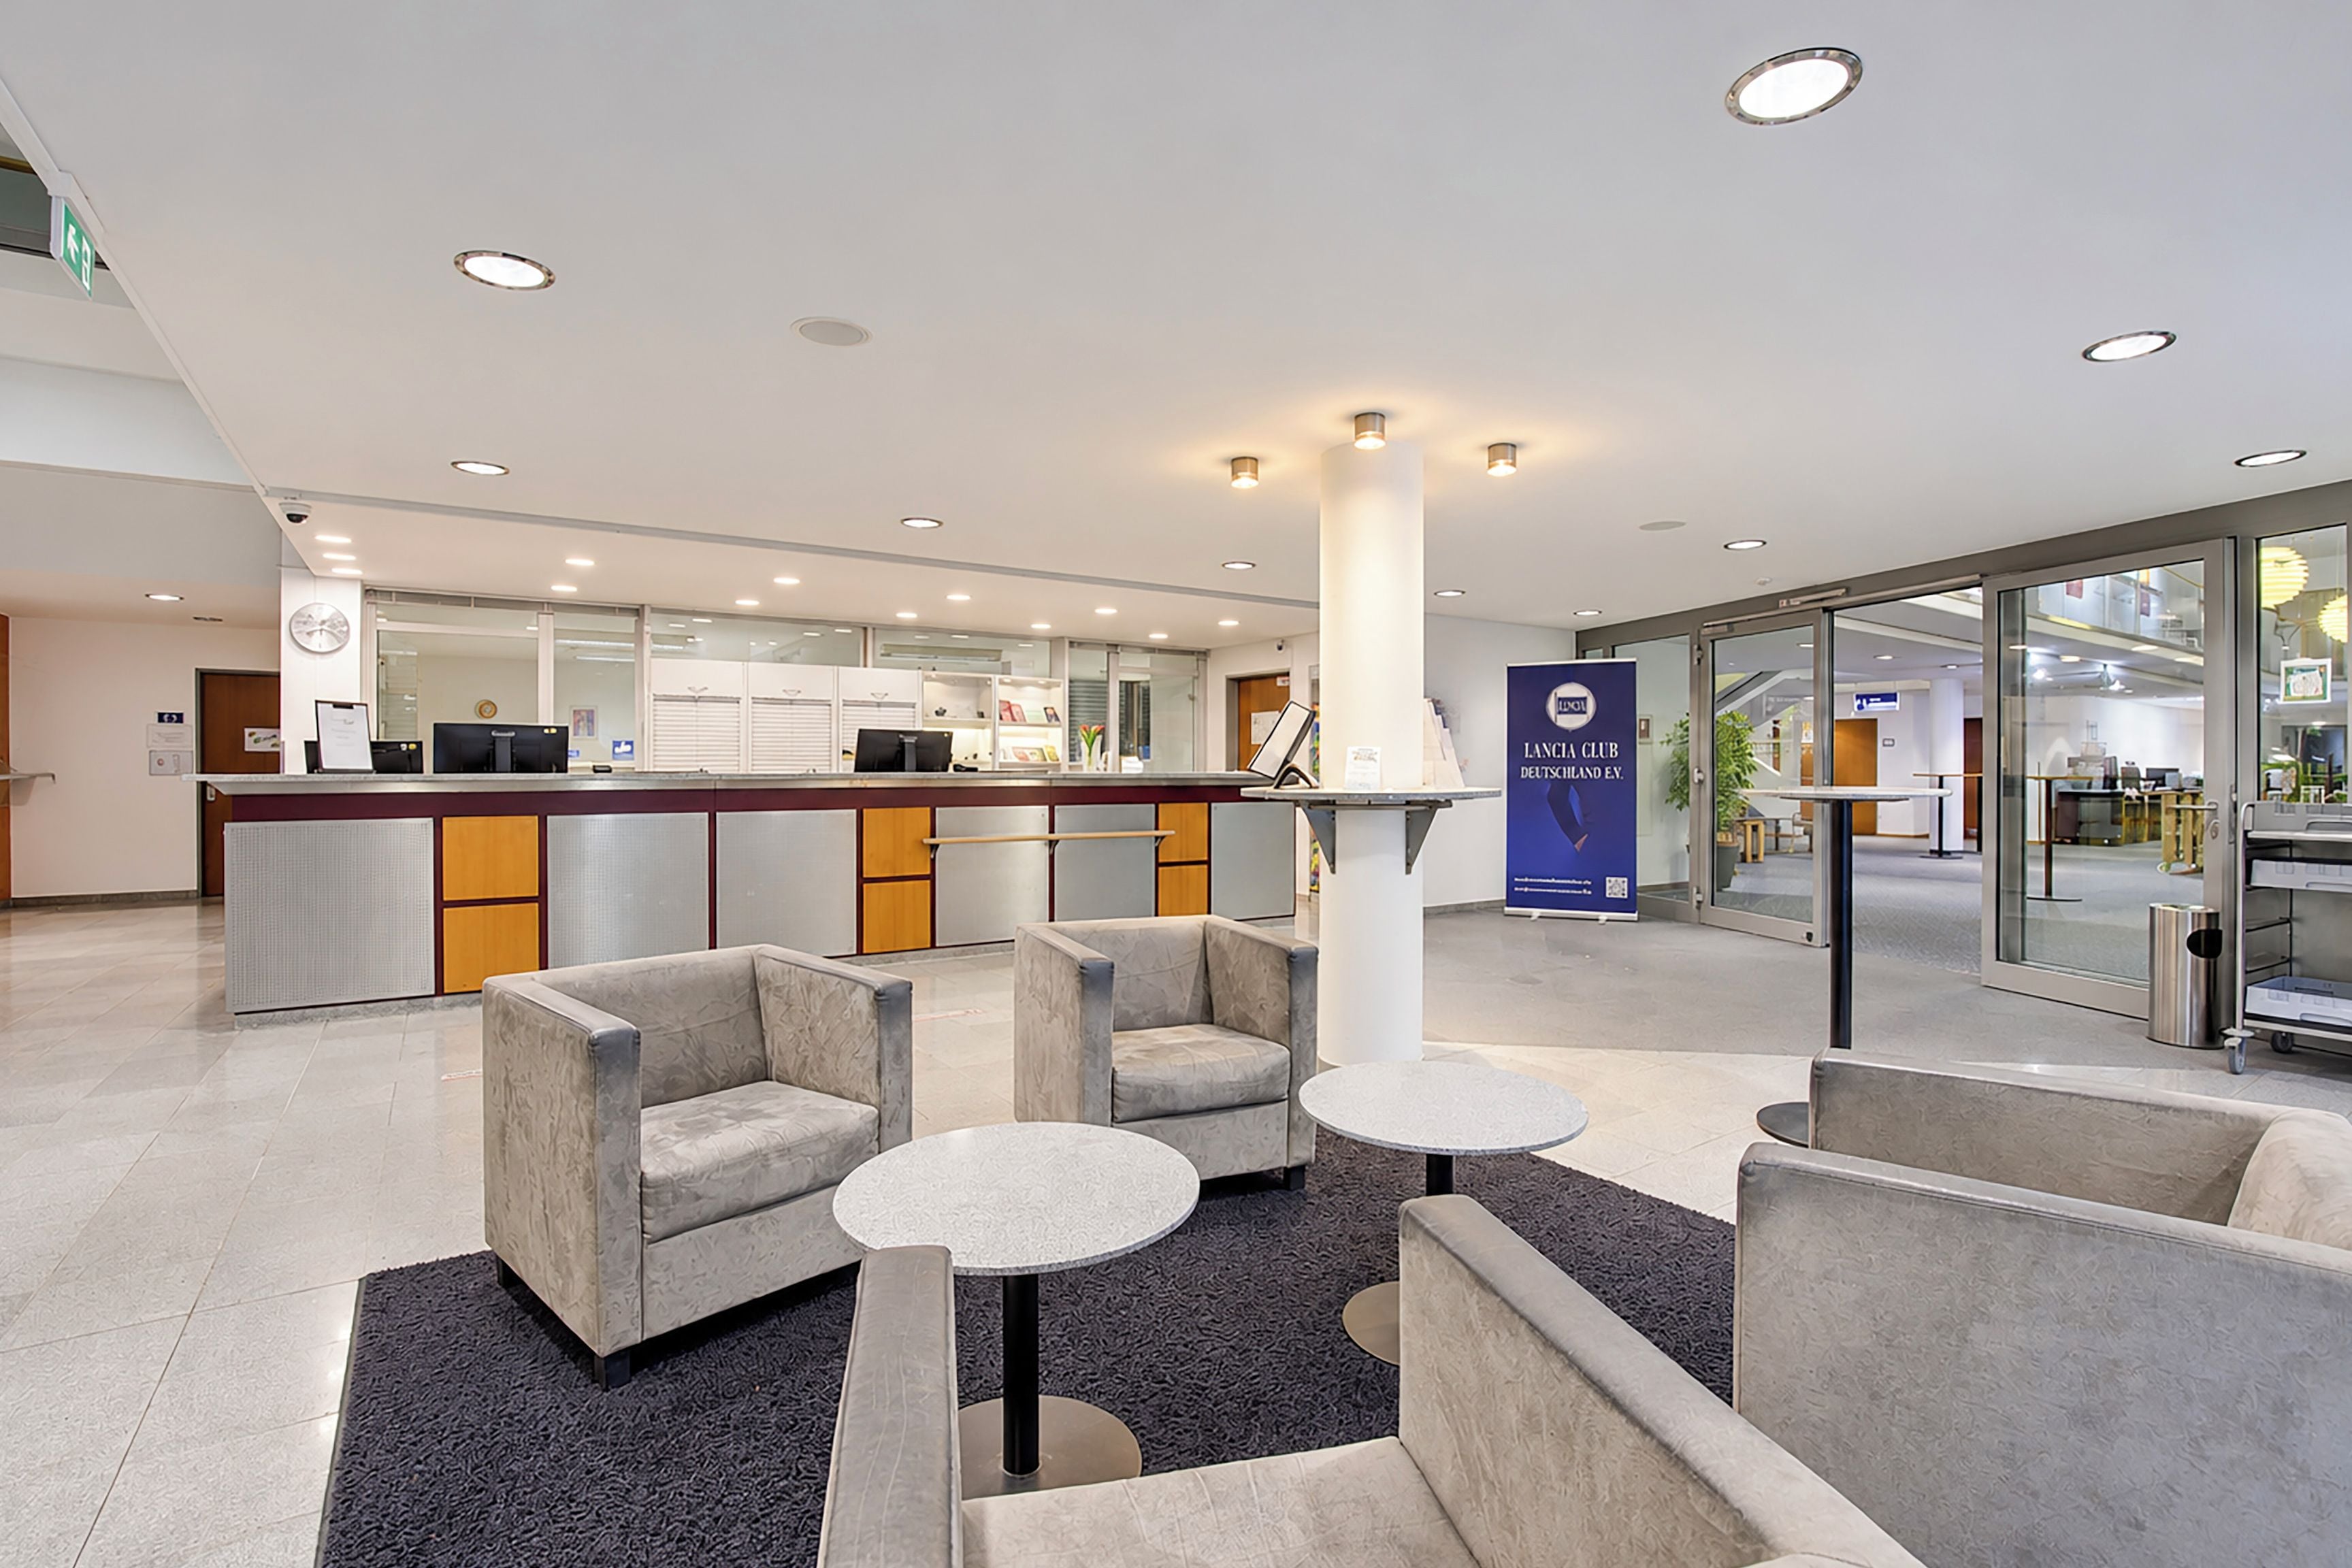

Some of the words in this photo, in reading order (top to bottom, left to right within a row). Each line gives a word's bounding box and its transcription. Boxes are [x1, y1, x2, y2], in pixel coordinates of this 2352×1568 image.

[1524, 742, 1576, 759] LANCIA
[1582, 741, 1618, 759] CLUB
[1520, 766, 1601, 779] DEUTSCHLAND
